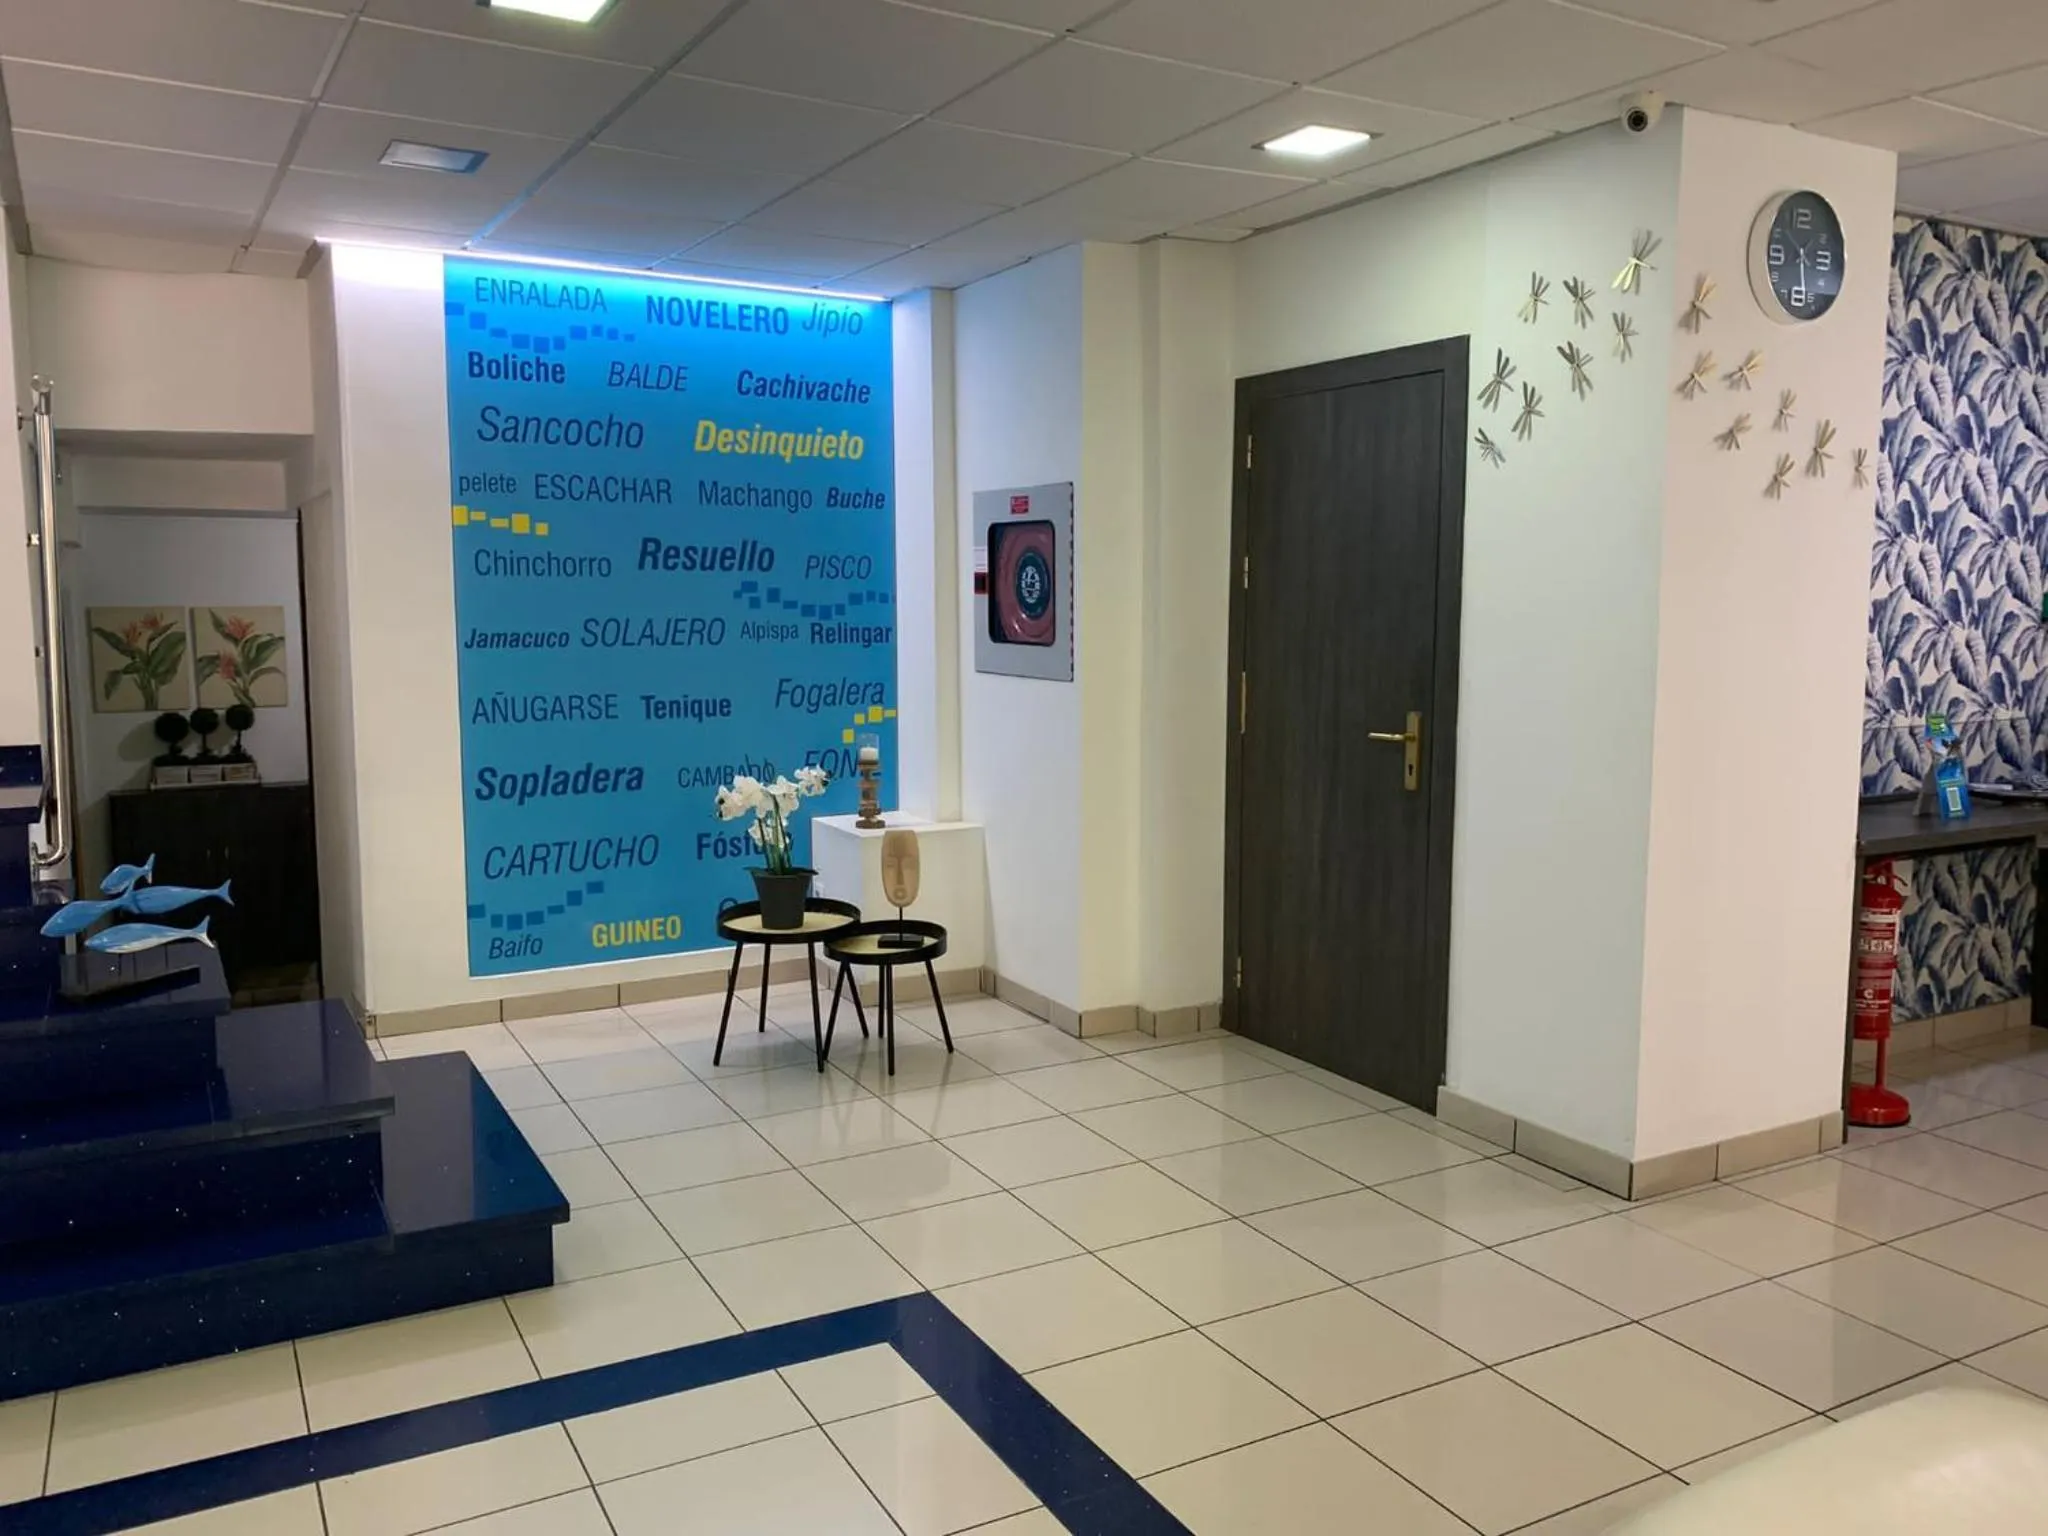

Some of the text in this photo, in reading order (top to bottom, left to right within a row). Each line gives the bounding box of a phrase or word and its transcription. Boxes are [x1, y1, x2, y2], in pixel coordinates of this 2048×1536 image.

[1793, 207, 1812, 230] 12
[1816, 250, 1831, 271] 3
[474, 277, 608, 313] ENRALADA
[646, 295, 789, 334] NOVELERO
[468, 352, 871, 404] Boliche BALDE Cachivache
[477, 406, 864, 463] Sancocho Desinquieto
[459, 473, 885, 512] pelete ESCACHAR Machango Buche
[474, 538, 871, 579] Chinchorro Resuello PISCO
[464, 618, 892, 649] Jamacuco SOLAJERO Alpispa Relingar
[472, 692, 619, 724] AÑUGARSE
[641, 695, 732, 722] Tenique
[776, 677, 885, 713] Fogalera
[475, 763, 644, 805] Sopladera
[484, 834, 659, 879] CARTUCHO
[489, 916, 681, 959] Baifo GUINEO
